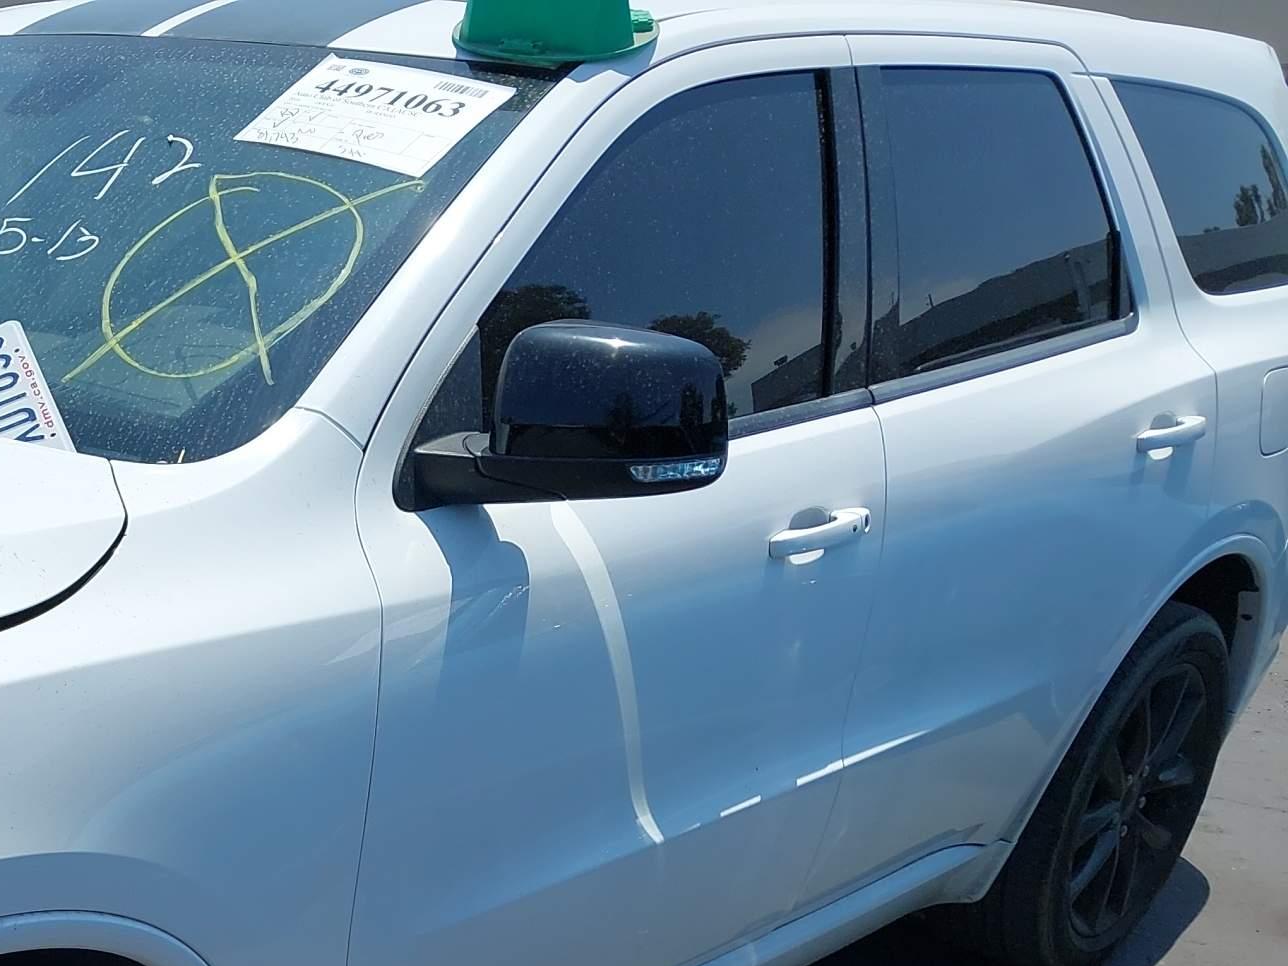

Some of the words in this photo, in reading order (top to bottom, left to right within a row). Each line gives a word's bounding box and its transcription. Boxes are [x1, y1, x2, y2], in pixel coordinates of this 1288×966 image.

[314, 78, 467, 118] 44971063
[6, 129, 202, 207] 142
[17, 354, 56, 430] dmv.ca.gov
